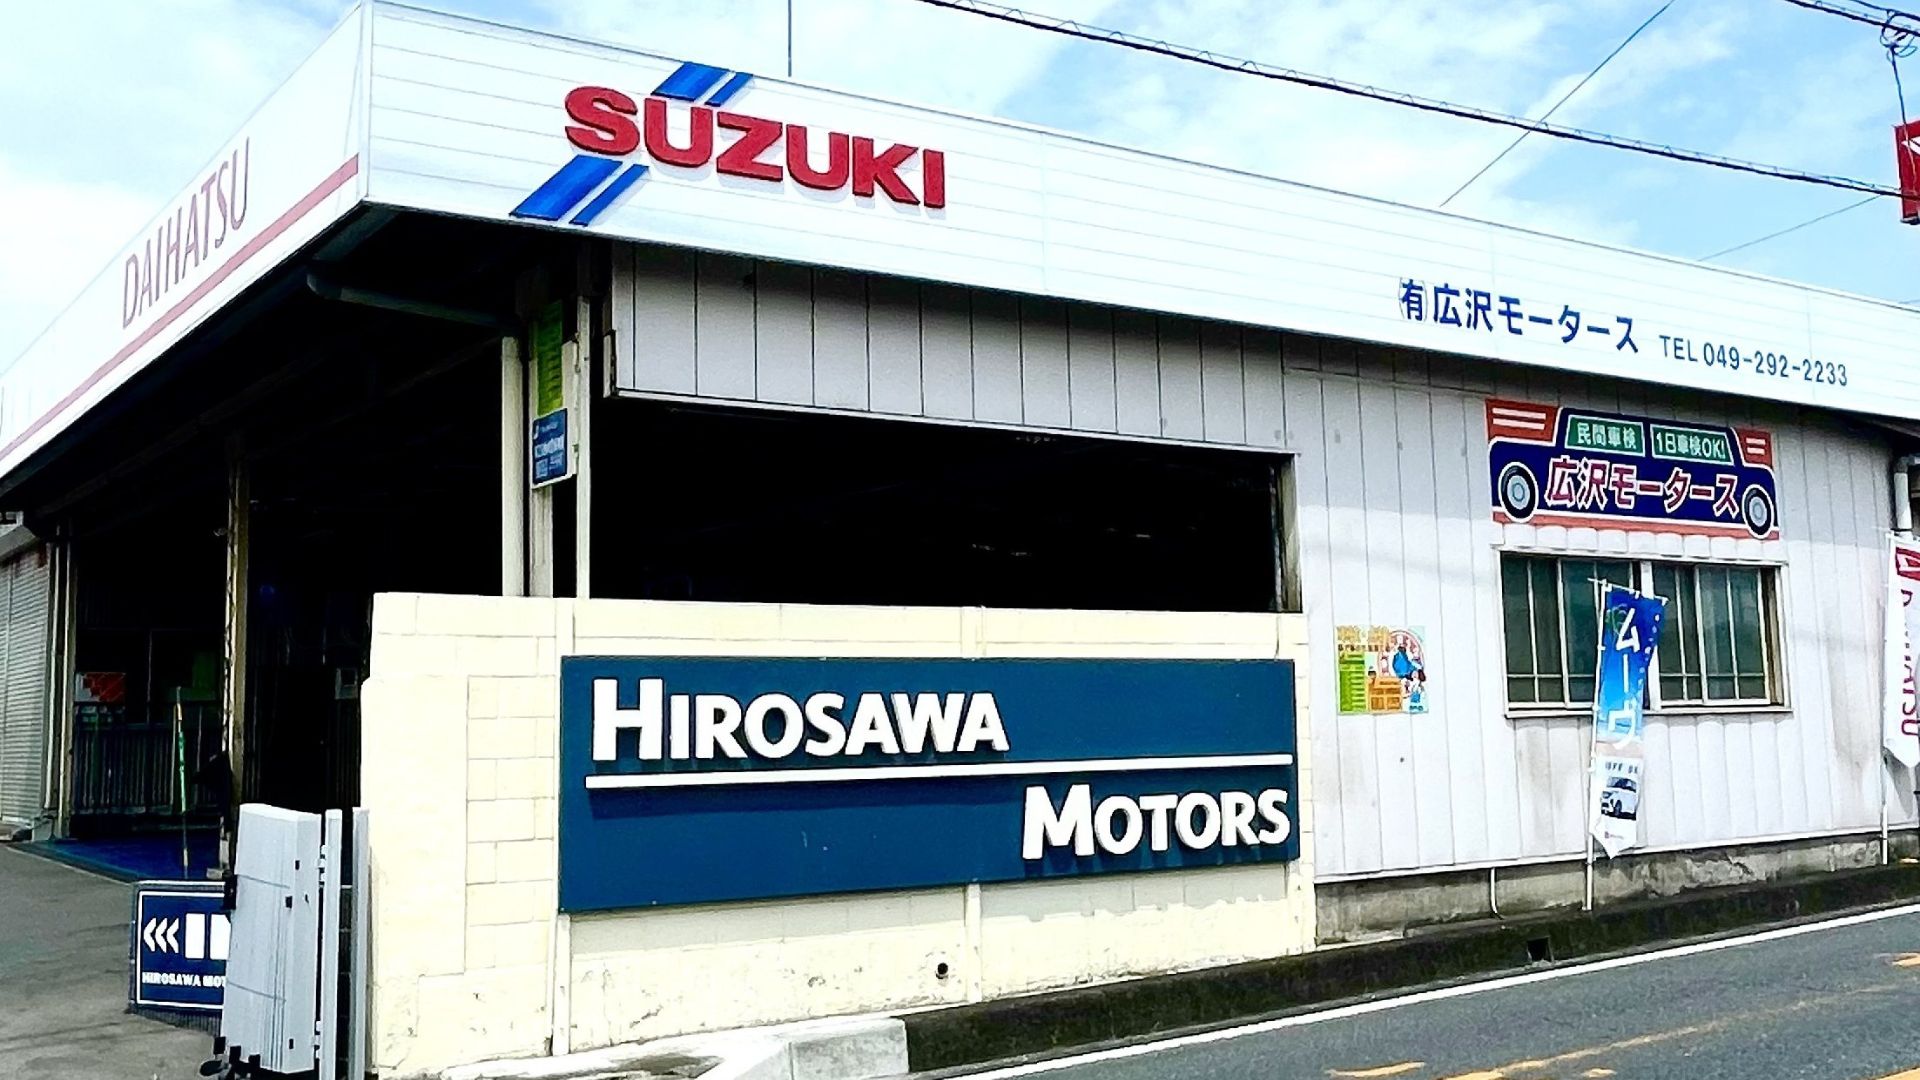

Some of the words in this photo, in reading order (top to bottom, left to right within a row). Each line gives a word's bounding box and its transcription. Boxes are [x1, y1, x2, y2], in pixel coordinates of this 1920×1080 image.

[565, 86, 945, 209] SUZUKI
[122, 136, 250, 330] DAIHATSU
[1659, 335, 1698, 362] TEL
[1703, 342, 1848, 387] 049-292-2233
[1577, 422, 1637, 450] 民間車検
[1545, 455, 1740, 518] 広沢モータース
[591, 678, 1010, 762] HIROSAWA
[1022, 784, 1291, 861] MOTORS
[141, 971, 202, 987] HIROSAWA
